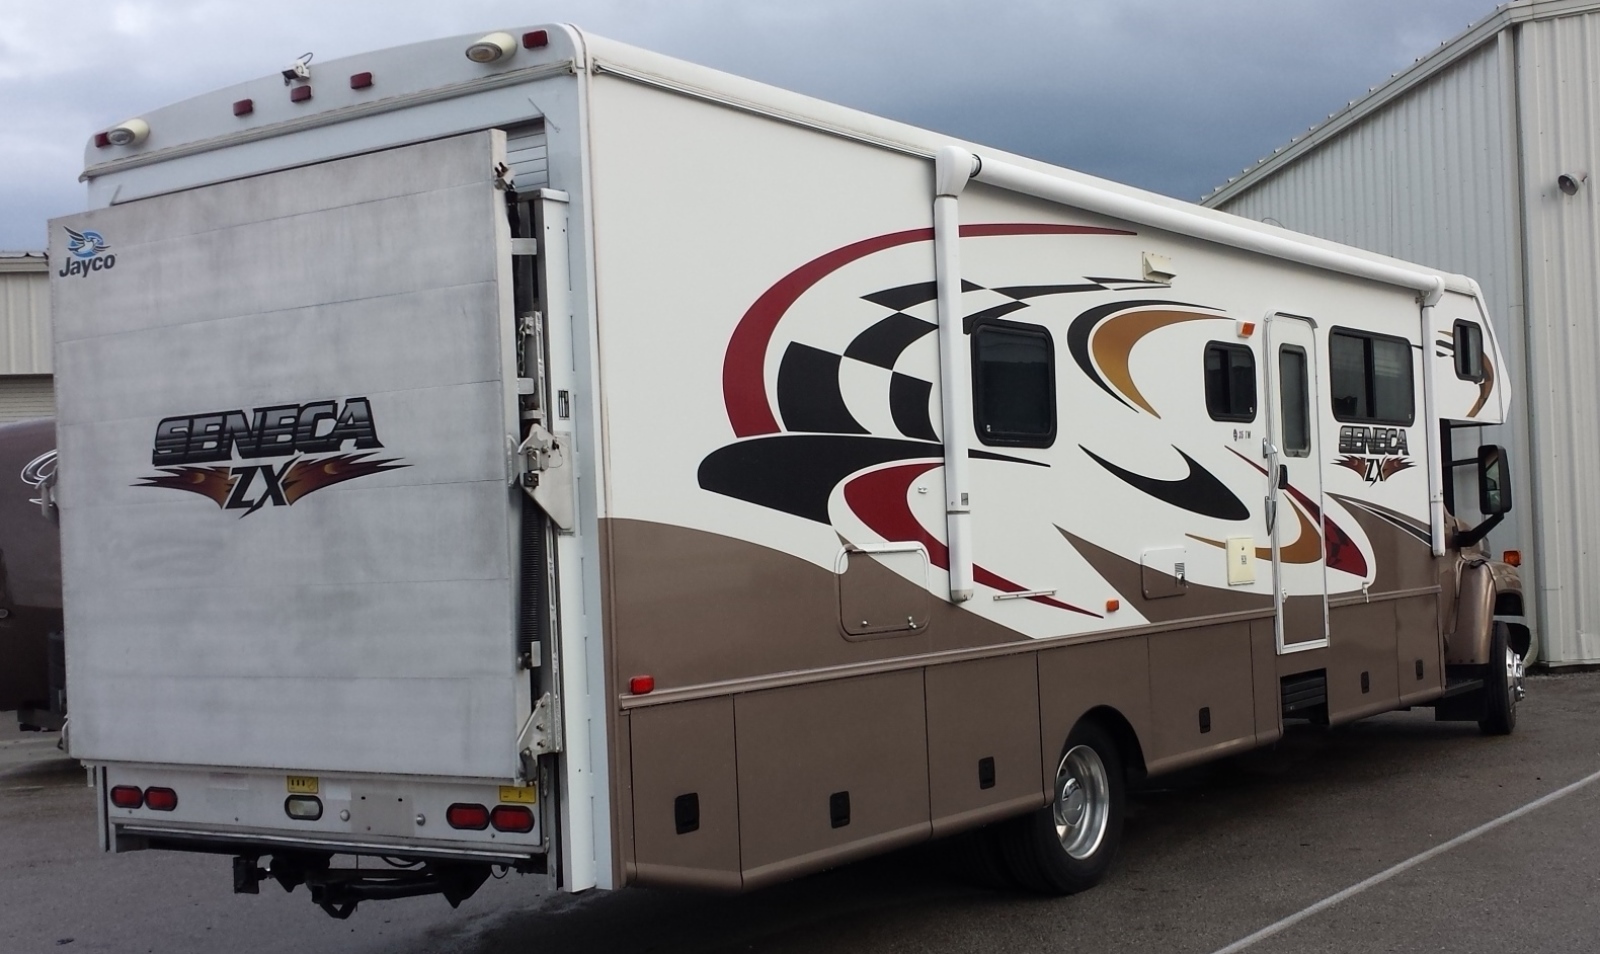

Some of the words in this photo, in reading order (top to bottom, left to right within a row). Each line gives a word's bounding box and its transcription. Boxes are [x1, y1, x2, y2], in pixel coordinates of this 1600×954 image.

[59, 254, 116, 278] Jayco
[152, 397, 385, 467] SENECA
[1339, 425, 1410, 455] SENECA
[224, 455, 302, 519] ZX
[1365, 456, 1387, 488] ZX
